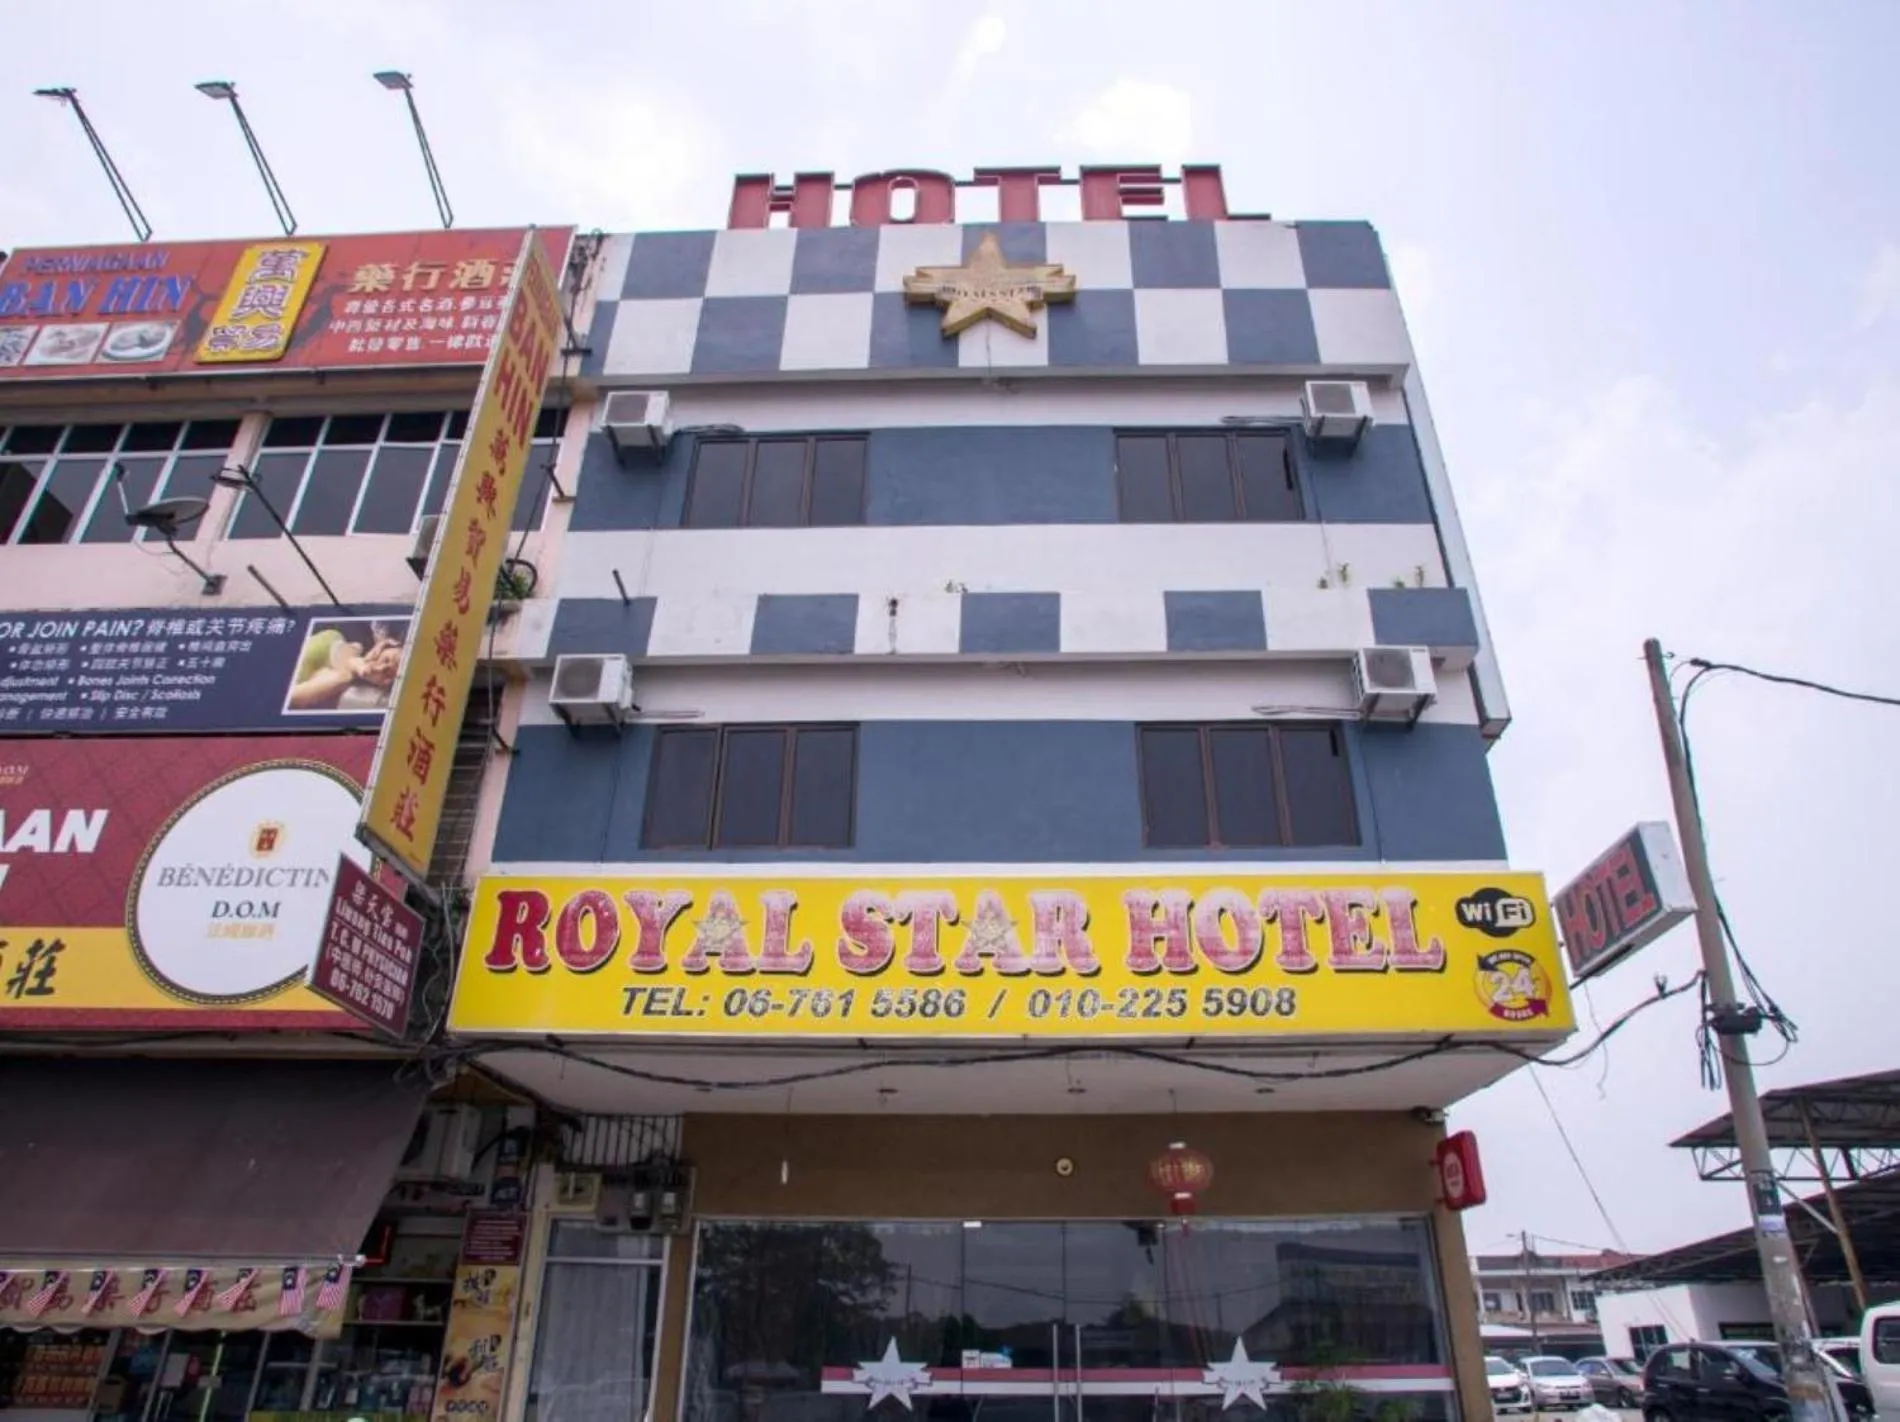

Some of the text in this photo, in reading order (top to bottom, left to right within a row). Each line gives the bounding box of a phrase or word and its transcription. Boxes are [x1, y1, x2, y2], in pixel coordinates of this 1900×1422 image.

[728, 164, 1271, 229] HOTEL
[508, 284, 550, 395] BAN
[494, 347, 533, 448] HIN
[27, 620, 80, 639] JOIN
[82, 618, 145, 638] PAIN?
[0, 808, 109, 853] AN
[485, 889, 814, 975] ROYAL
[838, 889, 1101, 974] STAR
[1123, 888, 1446, 974] HOTEL
[1556, 843, 1656, 967] HOTEL
[620, 986, 1297, 1018] TEL: 06-761 5586 / 010-225 5908
[1492, 967, 1534, 1000] 24
